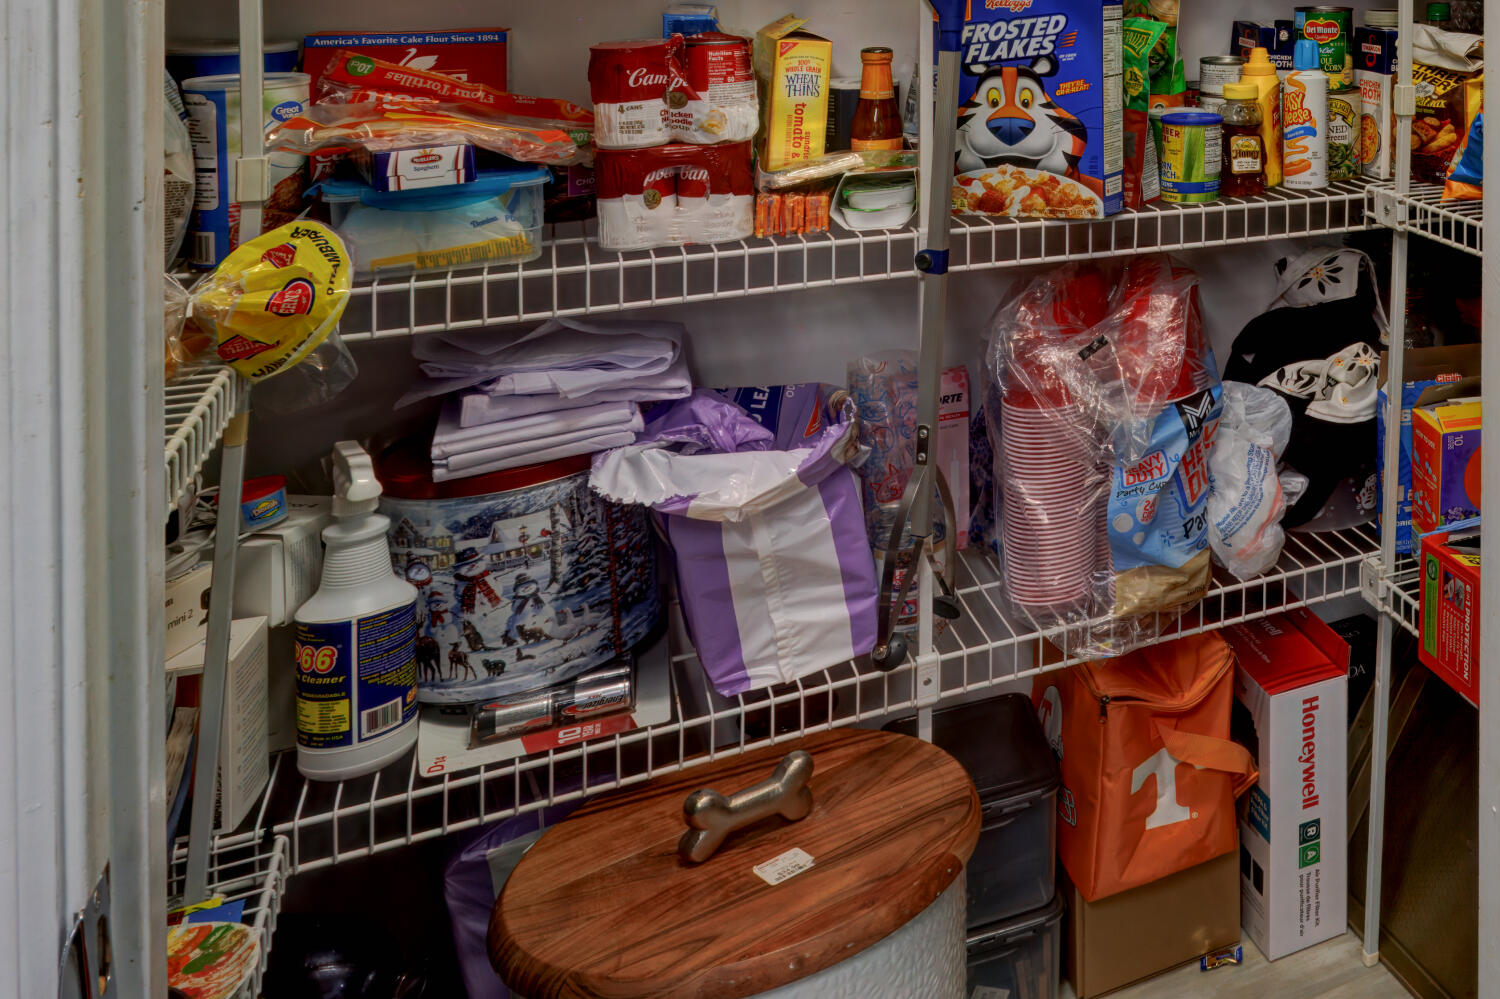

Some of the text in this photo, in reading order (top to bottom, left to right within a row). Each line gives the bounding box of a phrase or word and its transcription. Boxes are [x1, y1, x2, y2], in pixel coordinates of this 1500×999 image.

[962, 14, 1067, 45] FROSTED
[1306, 26, 1338, 34] Del Monte
[313, 34, 499, 46] America's Favorite Cake Flour Since 1894
[964, 35, 1057, 64] FLAKES
[1324, 63, 1342, 72] CORN
[785, 74, 822, 85] WHEAT
[1360, 78, 1381, 88] CHICKEN
[384, 71, 495, 104] Tortillas Flour
[785, 84, 820, 98] THINS
[275, 106, 300, 115] Great
[618, 105, 625, 114] 4
[792, 102, 807, 149] tomato
[1233, 149, 1259, 160] Honey
[414, 164, 440, 172] Spaghetti
[1454, 434, 1464, 447] 10
[1126, 451, 1161, 475] HEAVY
[1126, 465, 1164, 487] DUTY
[1116, 486, 1145, 499] Party
[167, 608, 193, 630] mini 2
[1463, 607, 1471, 680] PROTECTION
[301, 675, 346, 685] Cleaner
[583, 694, 625, 708] Energizer
[557, 726, 581, 745] 10
[582, 723, 594, 737] YEAR
[1298, 695, 1319, 811] Honeywell
